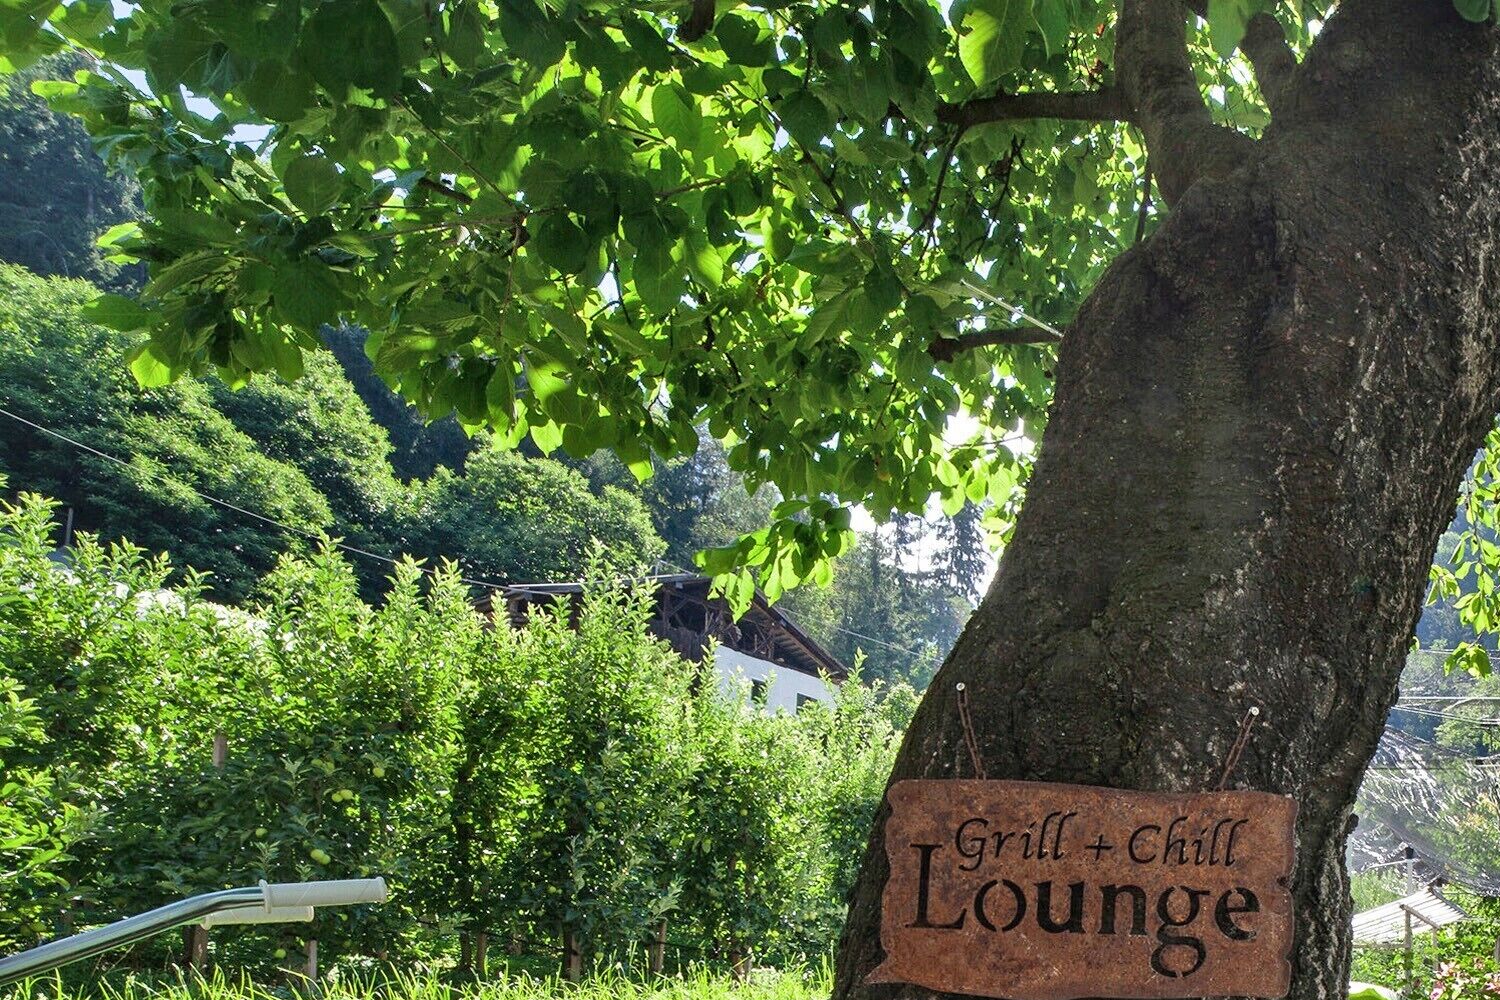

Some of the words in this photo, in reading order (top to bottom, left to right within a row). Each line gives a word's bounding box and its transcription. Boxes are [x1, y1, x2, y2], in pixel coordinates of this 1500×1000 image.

[954, 811, 1078, 872] Grill
[1085, 834, 1113, 862] +
[1128, 816, 1249, 867] Chill
[905, 842, 1261, 979] Lounge
